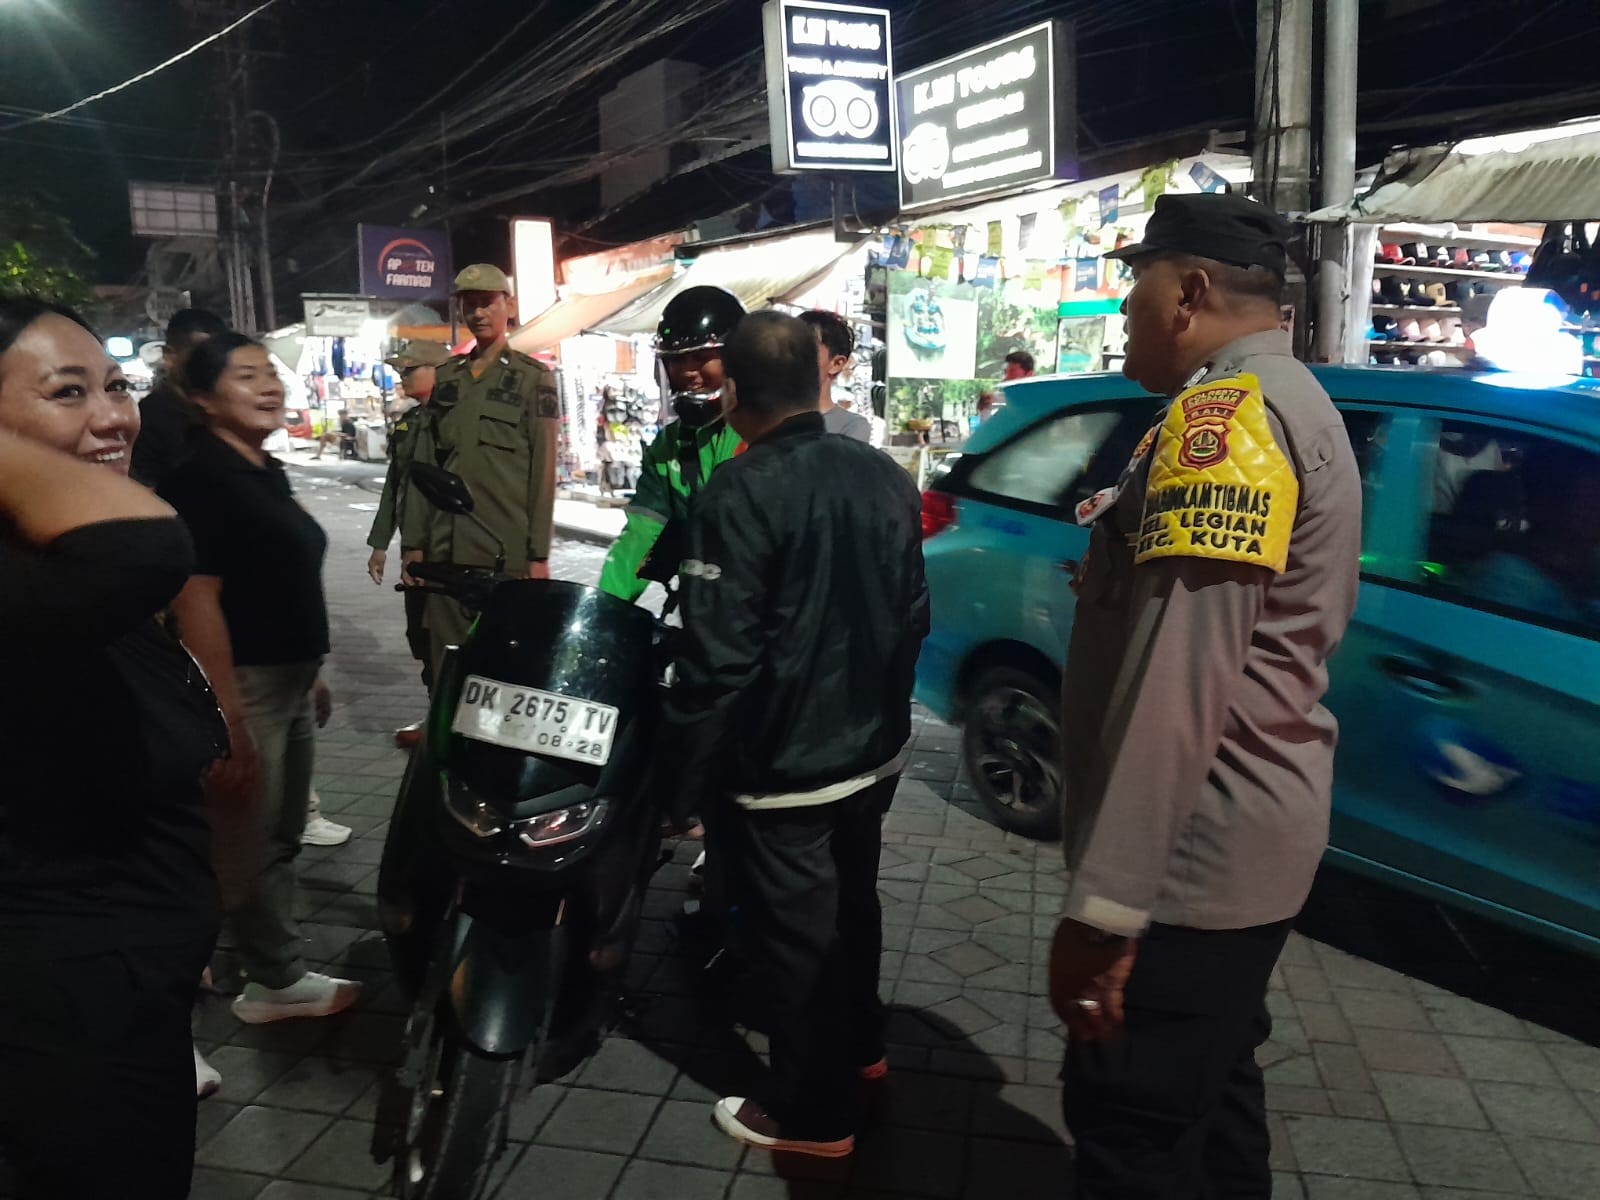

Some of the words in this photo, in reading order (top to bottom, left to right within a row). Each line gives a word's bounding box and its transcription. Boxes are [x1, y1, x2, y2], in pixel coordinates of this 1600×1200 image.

[1180, 511, 1267, 537] LEGIAN
[1190, 531, 1263, 556] KUTA
[466, 682, 498, 710] DK
[510, 693, 569, 724] 2675
[583, 708, 611, 733] TV
